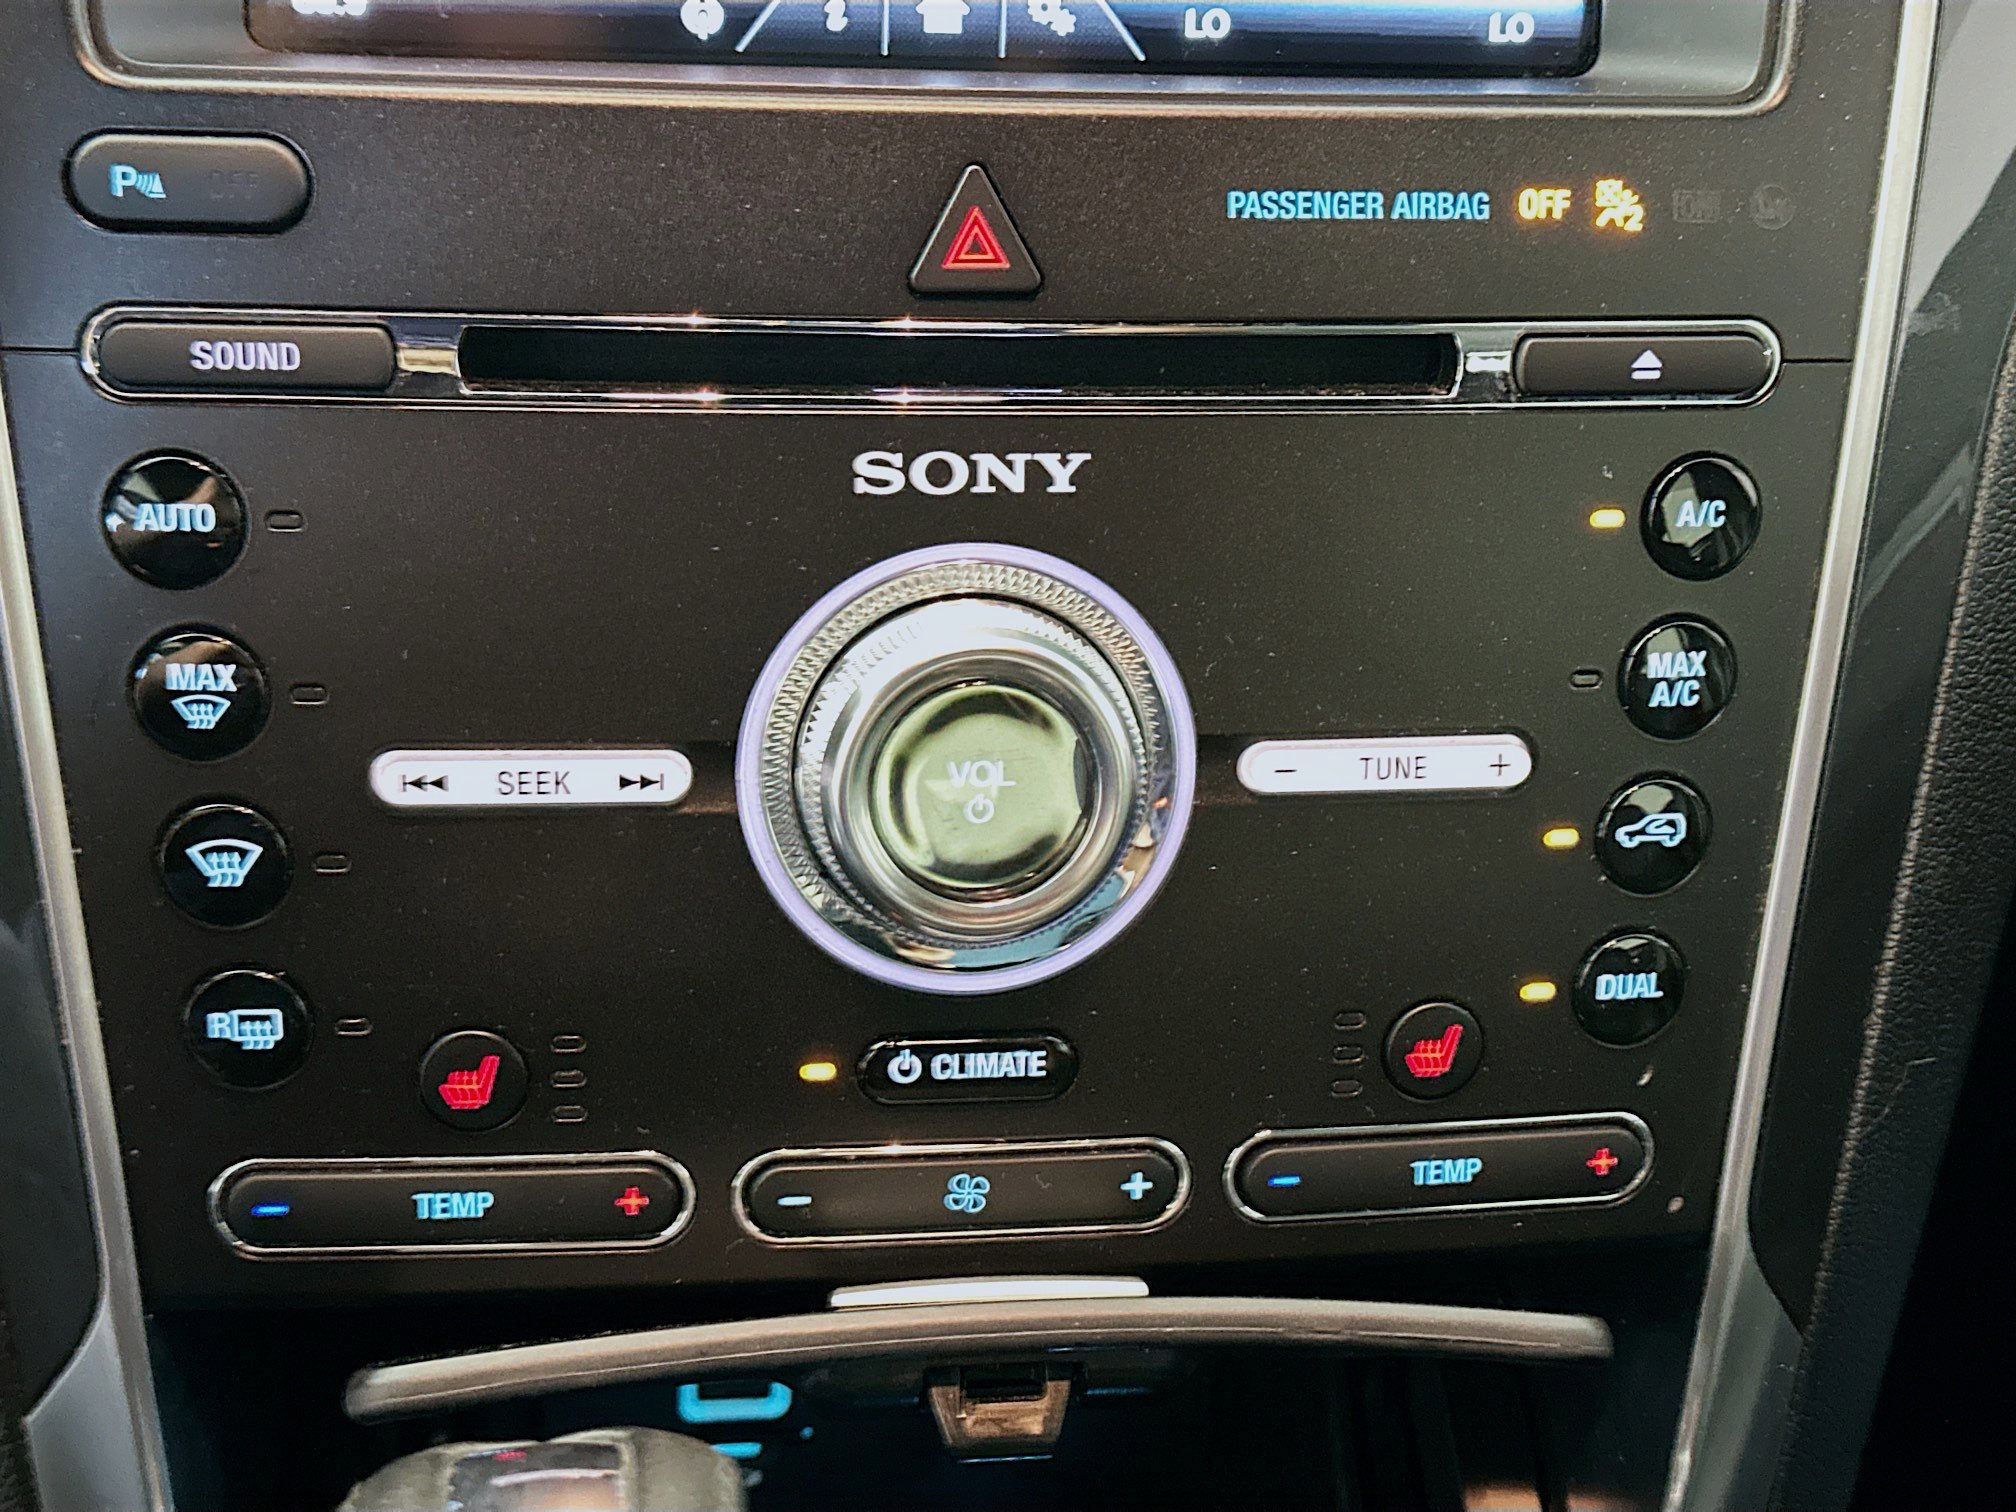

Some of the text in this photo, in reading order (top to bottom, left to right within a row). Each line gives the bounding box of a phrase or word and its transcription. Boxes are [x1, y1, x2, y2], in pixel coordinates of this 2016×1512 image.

[1184, 7, 1232, 39] LO
[1488, 11, 1535, 43] LO
[1227, 188, 1572, 220] PASSENGER AIRBAG OFF
[189, 340, 300, 371] SOUND
[852, 450, 1092, 495] SONY
[132, 503, 216, 532] AUTO
[1676, 500, 1726, 528] A/C
[165, 663, 237, 692] MAX
[1646, 650, 1707, 678] MAX
[1648, 679, 1700, 707] A/C
[947, 760, 1016, 788] VOL
[1359, 756, 1427, 780] TUNE
[497, 770, 571, 796] SEEK
[1595, 971, 1664, 1000] DUAL
[930, 1050, 1047, 1081] CLIMATE
[1409, 1157, 1483, 1186] TEMP
[411, 1191, 495, 1220] TEMP
